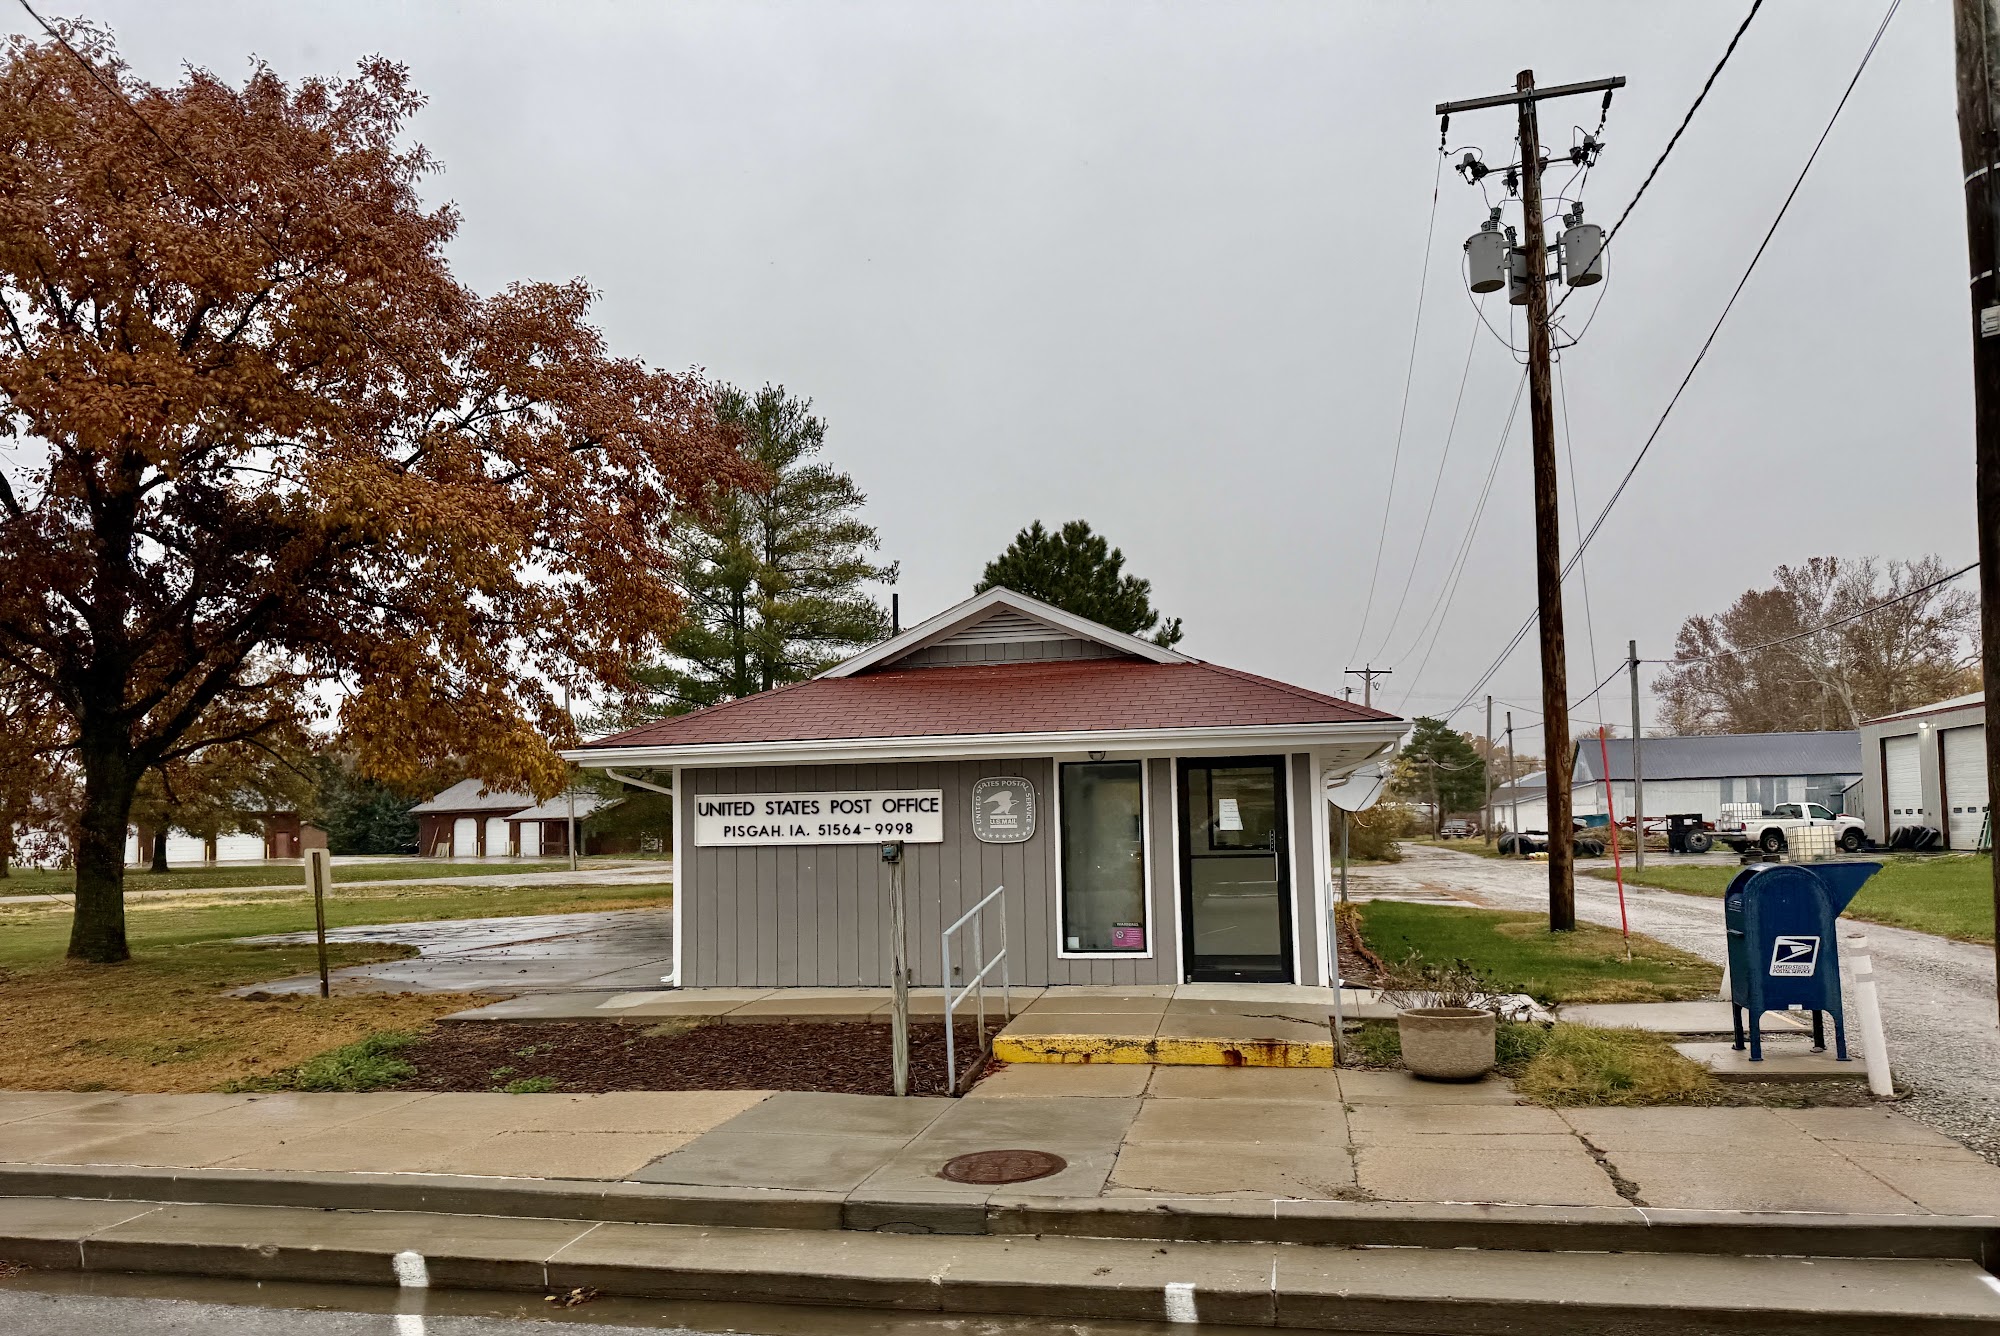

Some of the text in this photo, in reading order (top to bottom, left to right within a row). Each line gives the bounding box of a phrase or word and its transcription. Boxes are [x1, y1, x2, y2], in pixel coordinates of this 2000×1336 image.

[977, 781, 1000, 794] STATES
[1001, 780, 1029, 791] POSTAL
[698, 797, 939, 817] UNITED STATES POST OFFICE
[790, 824, 810, 837] IA.
[818, 822, 914, 836] 51564-9998
